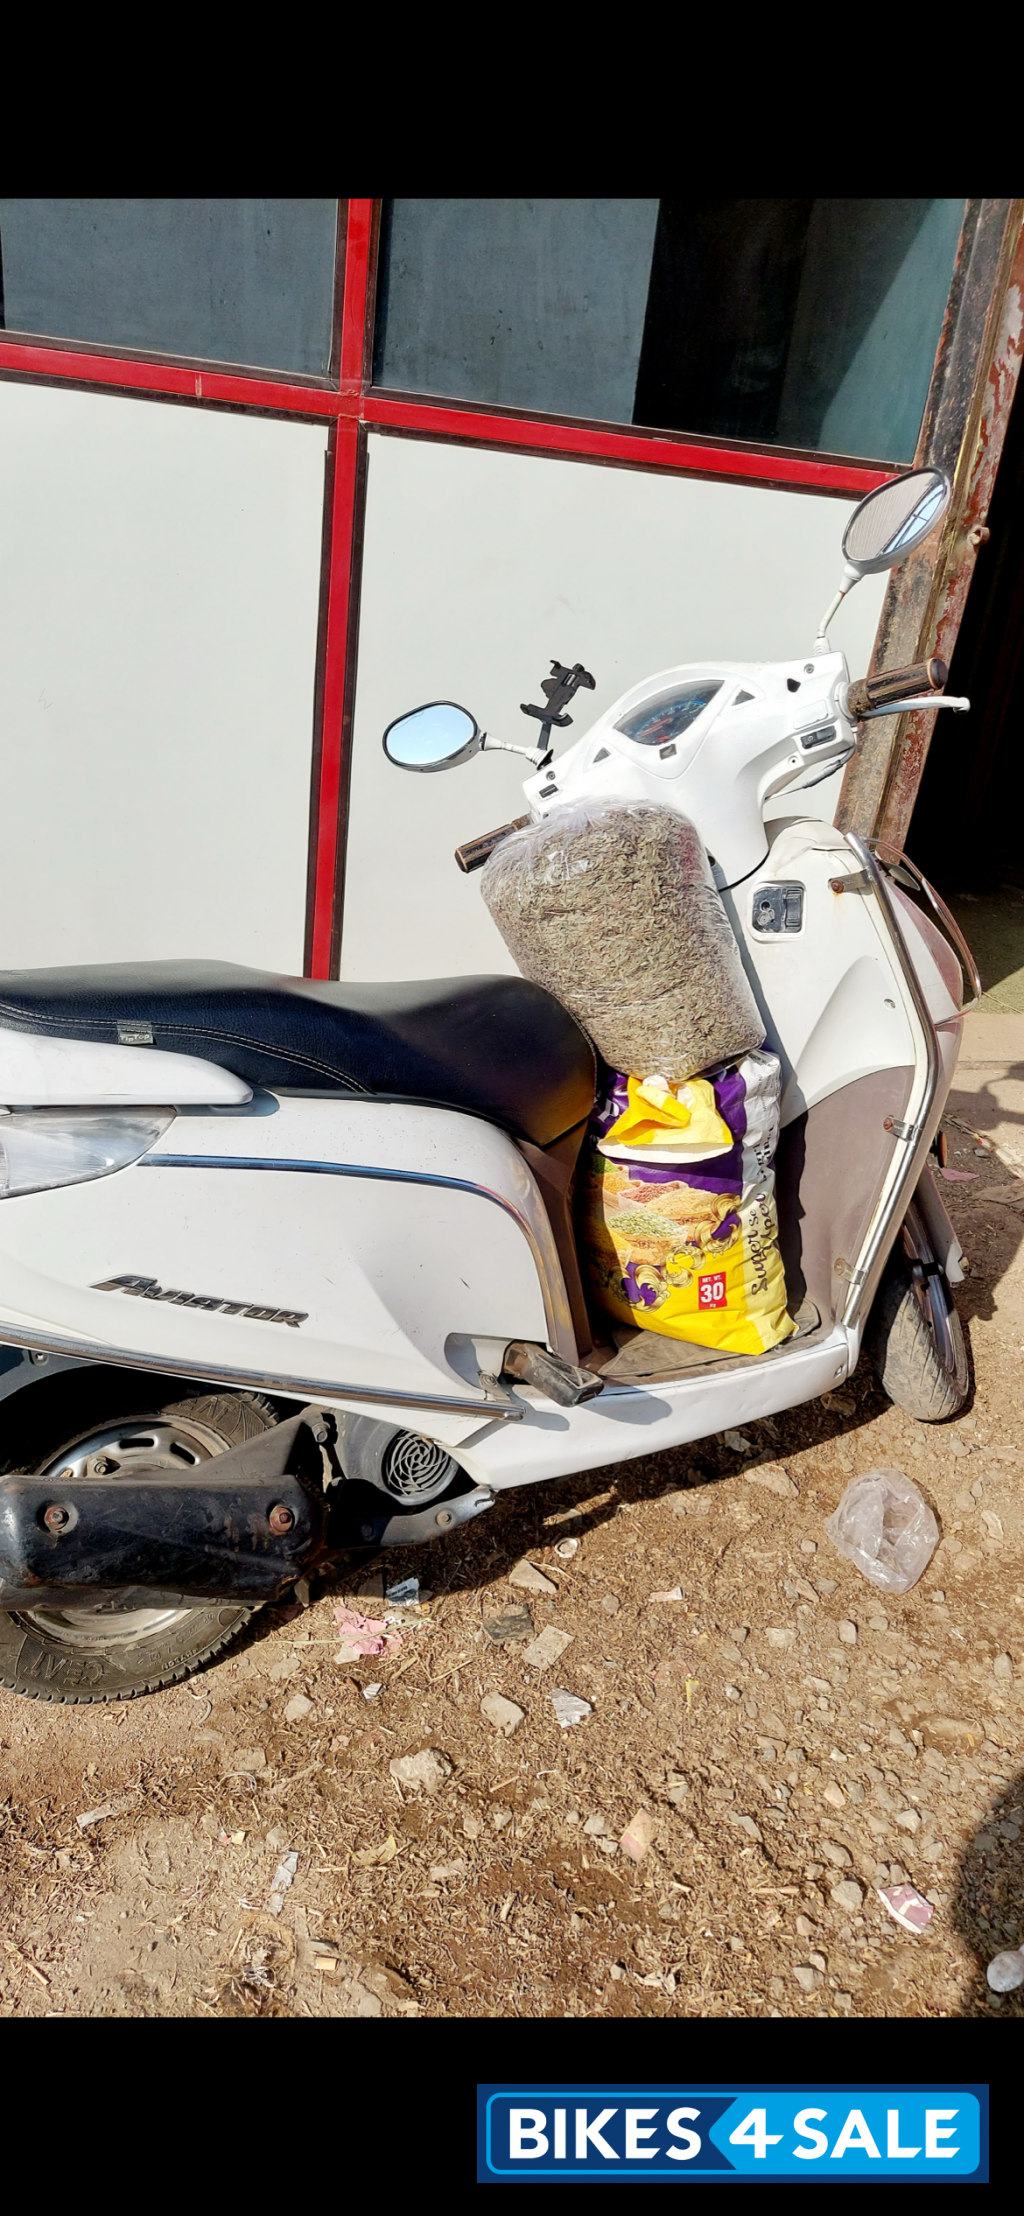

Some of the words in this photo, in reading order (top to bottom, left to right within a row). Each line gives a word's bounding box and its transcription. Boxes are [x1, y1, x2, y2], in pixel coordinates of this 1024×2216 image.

[748, 1208, 759, 1227] Se
[747, 1229, 769, 1296] Super
[700, 1281, 724, 1304] 30
[24, 1651, 106, 1687] CEAT
